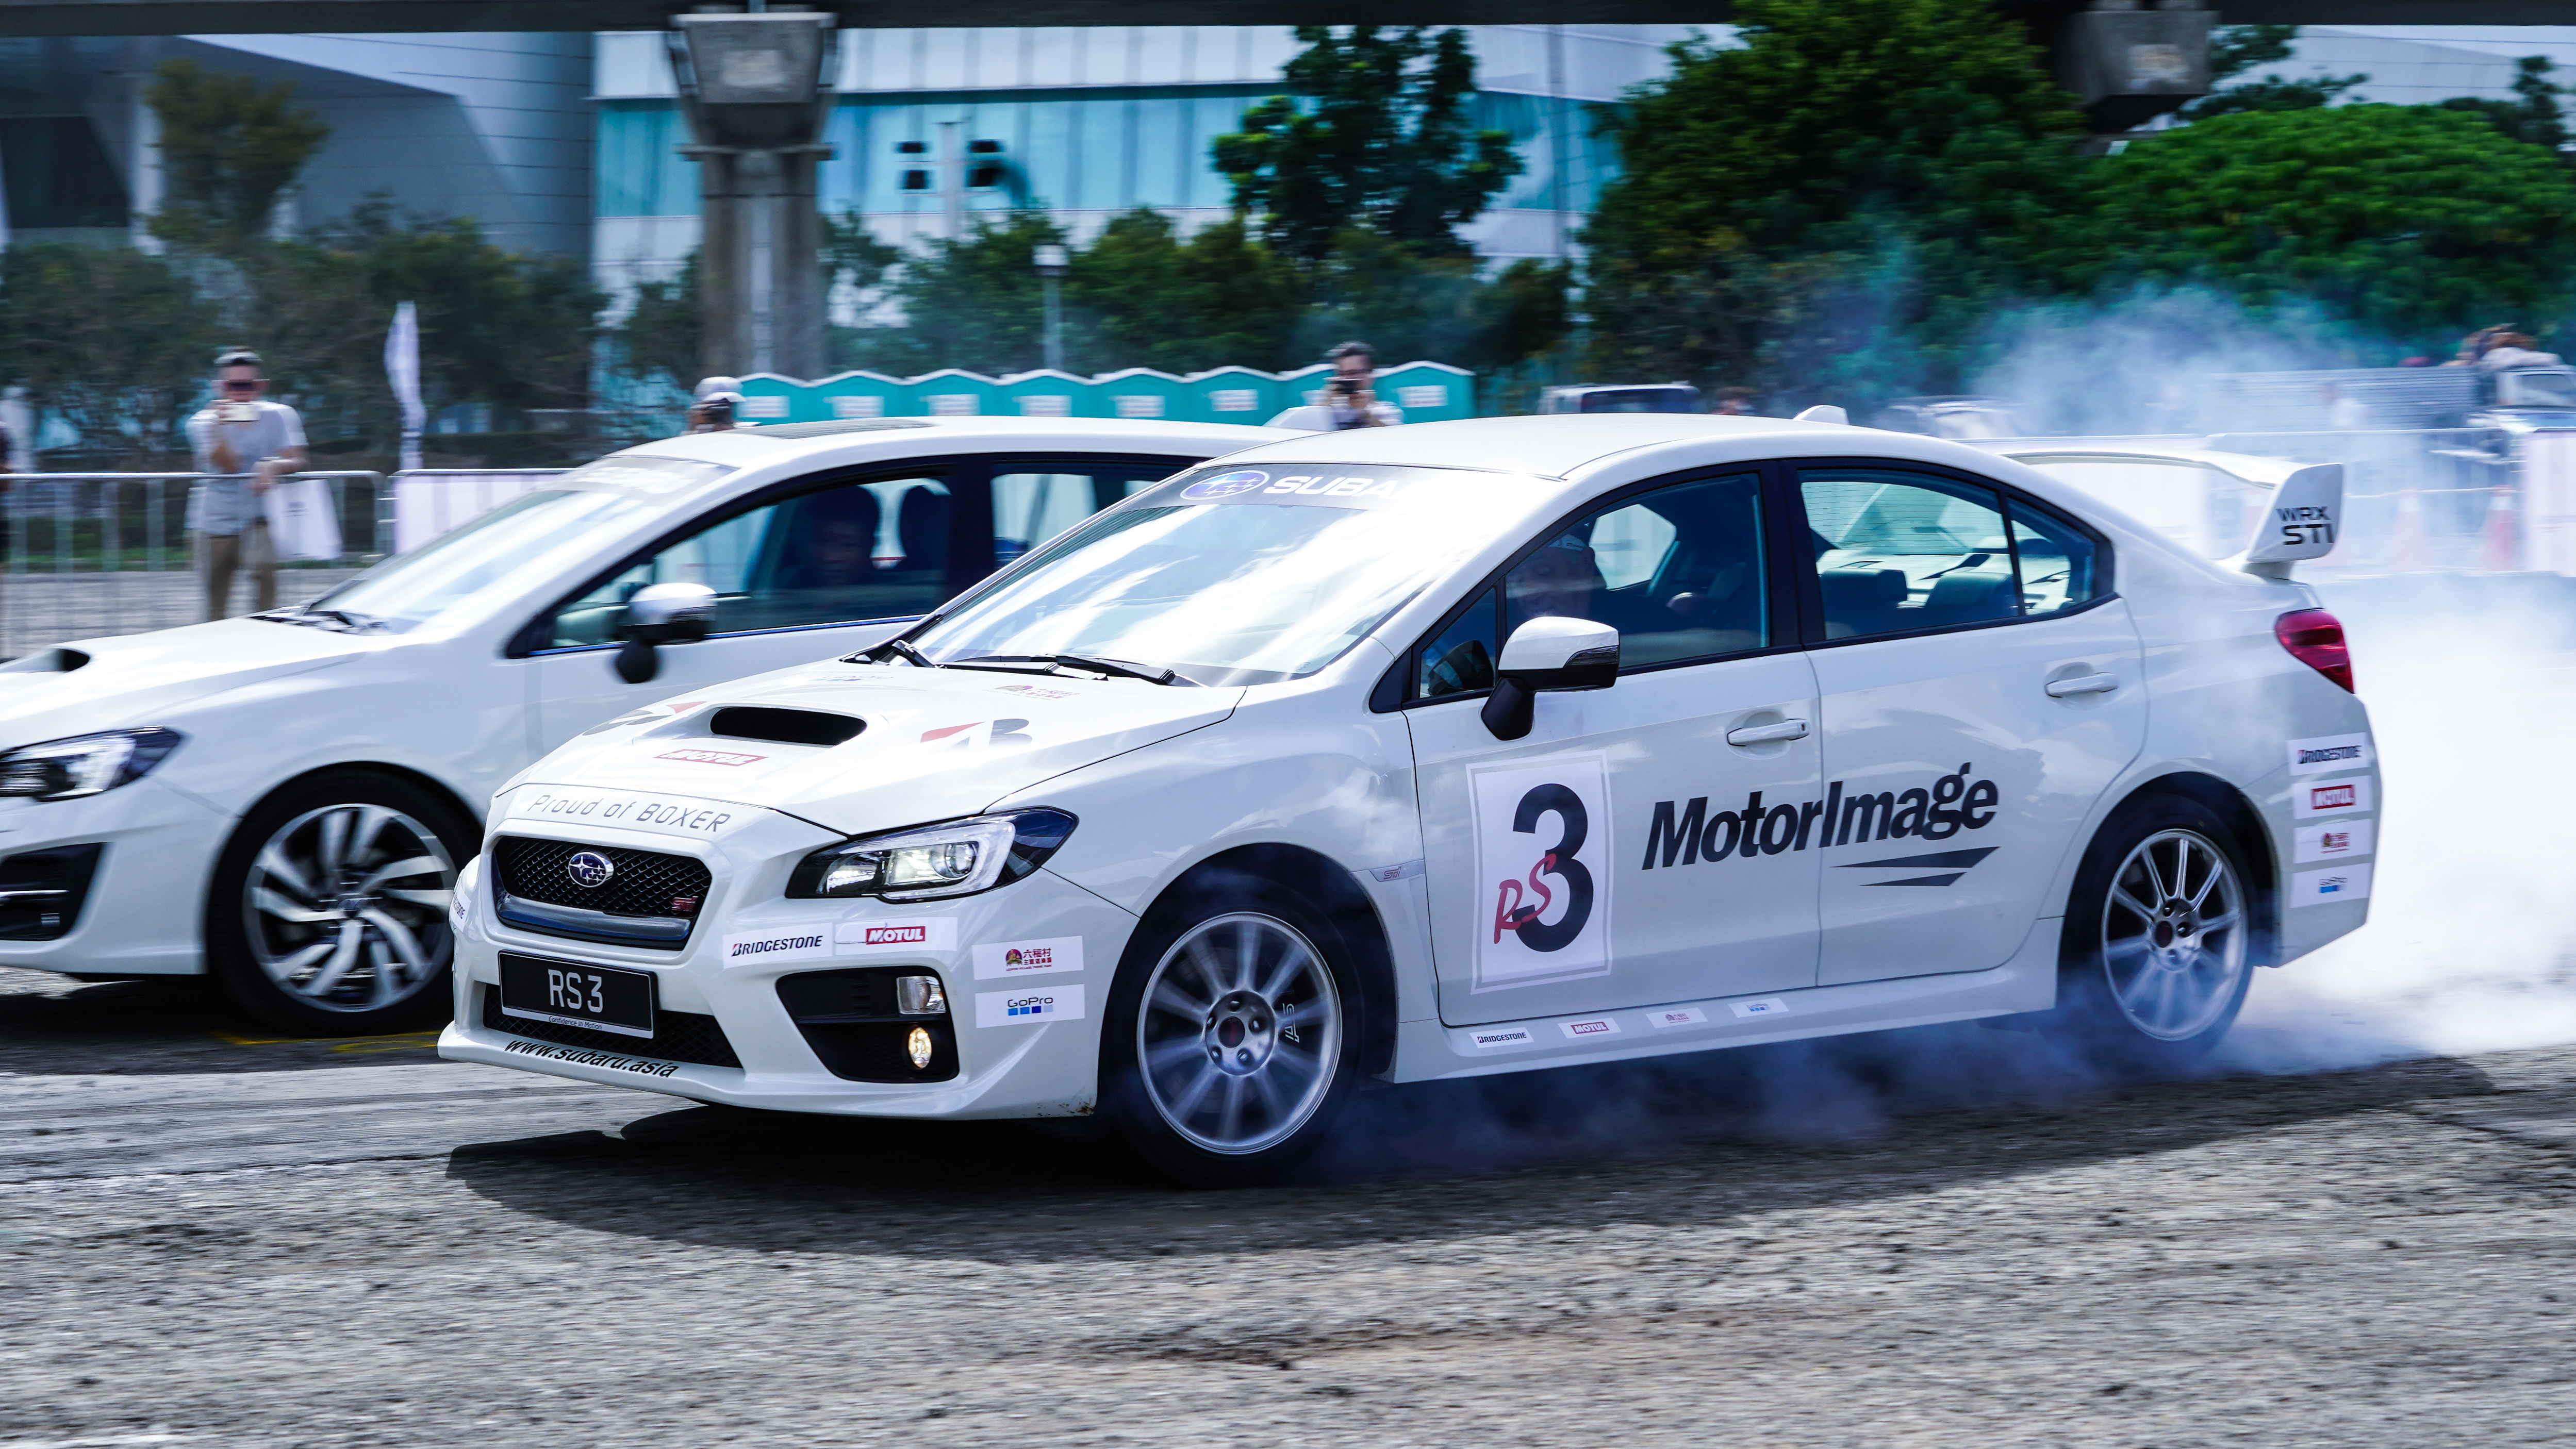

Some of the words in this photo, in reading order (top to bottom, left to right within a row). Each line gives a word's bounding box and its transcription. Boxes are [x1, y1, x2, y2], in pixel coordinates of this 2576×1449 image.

[2275, 506, 2331, 521] WRX
[2281, 523, 2334, 545] STI
[660, 750, 758, 765] MOTUL
[527, 794, 604, 815] Proud
[603, 801, 637, 819] of
[636, 803, 731, 832] BOXER
[1642, 762, 1999, 870] MotorImage
[1512, 783, 1594, 952] 3
[1493, 853, 1557, 944] RS
[868, 928, 924, 942] MOTUL
[731, 935, 823, 957] BRIDGESTONE
[1022, 947, 1051, 958] 六福村
[1008, 997, 1053, 1007] GoPro
[549, 1016, 577, 1026] Confidence
[584, 1021, 602, 1030] Motion
[1575, 1022, 1607, 1034] MOTUL
[1477, 1032, 1527, 1043] BRIDGESTONE
[504, 1040, 680, 1077] www.subaru.asia
